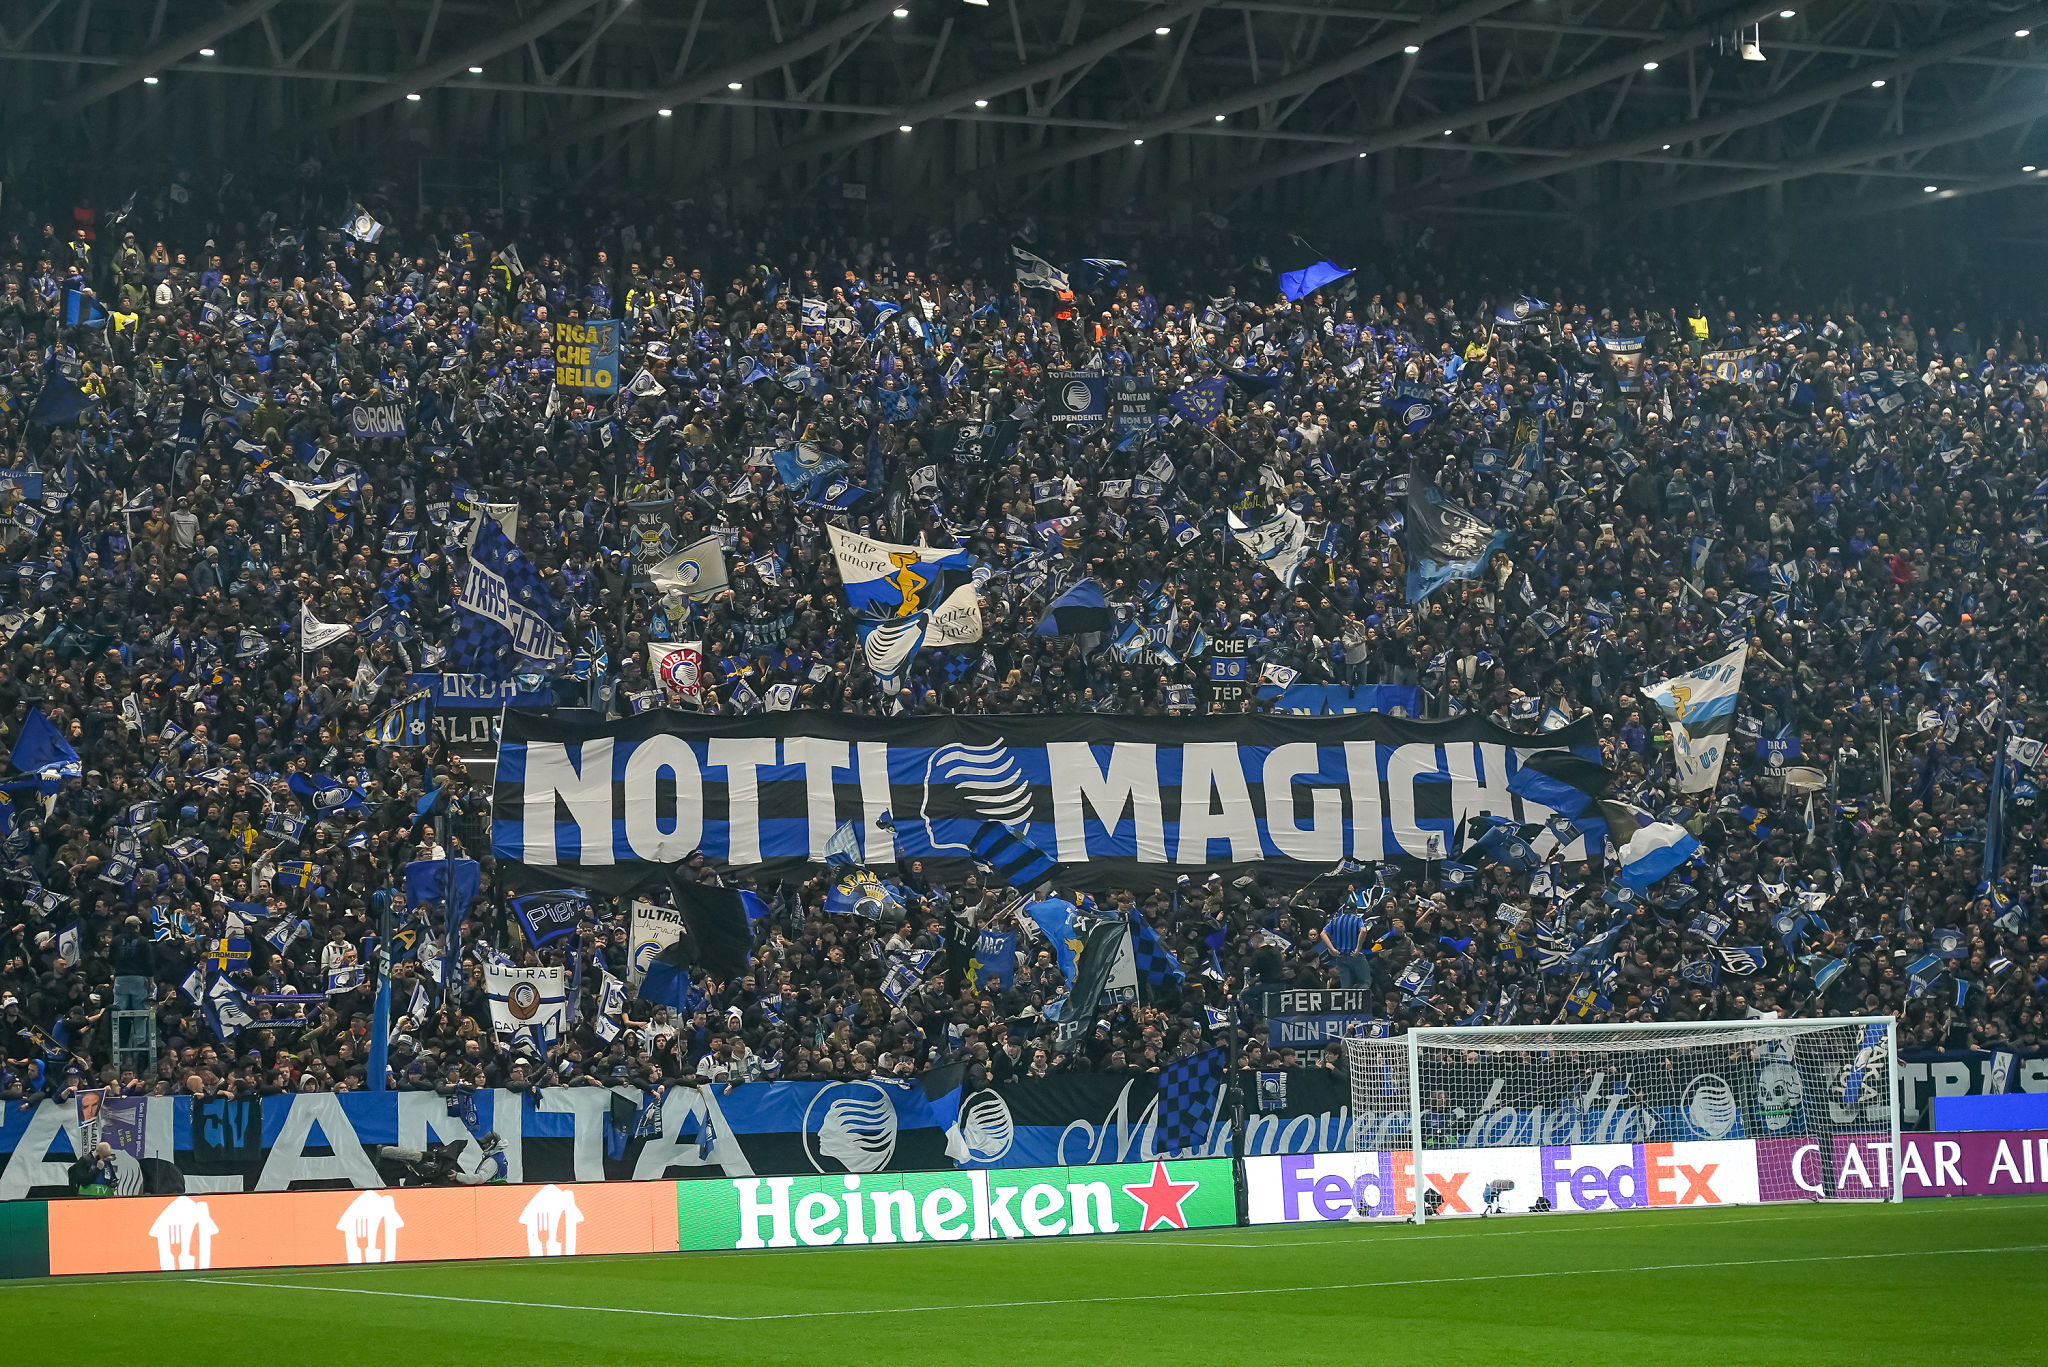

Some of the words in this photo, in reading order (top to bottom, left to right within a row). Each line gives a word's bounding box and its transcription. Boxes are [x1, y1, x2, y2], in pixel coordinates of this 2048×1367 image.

[556, 322, 599, 345] FIGA
[556, 344, 591, 366] CHE
[556, 366, 612, 389] BELLO
[1047, 370, 1100, 379] TOTALMENTE
[1116, 392, 1151, 402] LONTAN
[1051, 414, 1103, 423] DIPENDENTE
[1122, 404, 1134, 413] DA
[1136, 404, 1147, 413] TE
[1119, 416, 1142, 425] NON
[839, 551, 886, 573] amore
[461, 564, 506, 621] LTRAS
[935, 606, 976, 626] senza
[1111, 645, 1165, 667] NOTRO
[1214, 639, 1244, 654] CHE
[522, 732, 897, 867] NOTTI
[489, 965, 558, 981] ULTRAS
[1280, 992, 1322, 1013] PER
[1330, 991, 1363, 1012] CHI
[1281, 1020, 1321, 1043] NON
[0, 1084, 758, 1201] ALANTA
[90, 1121, 98, 1153] CLAUD
[1540, 1141, 1723, 1212] FedEx
[1791, 1139, 1968, 1198] QATAR
[95, 1185, 107, 1195] TV
[1280, 1149, 1473, 1221] FedEx
[731, 1168, 1120, 1250] Heineken
